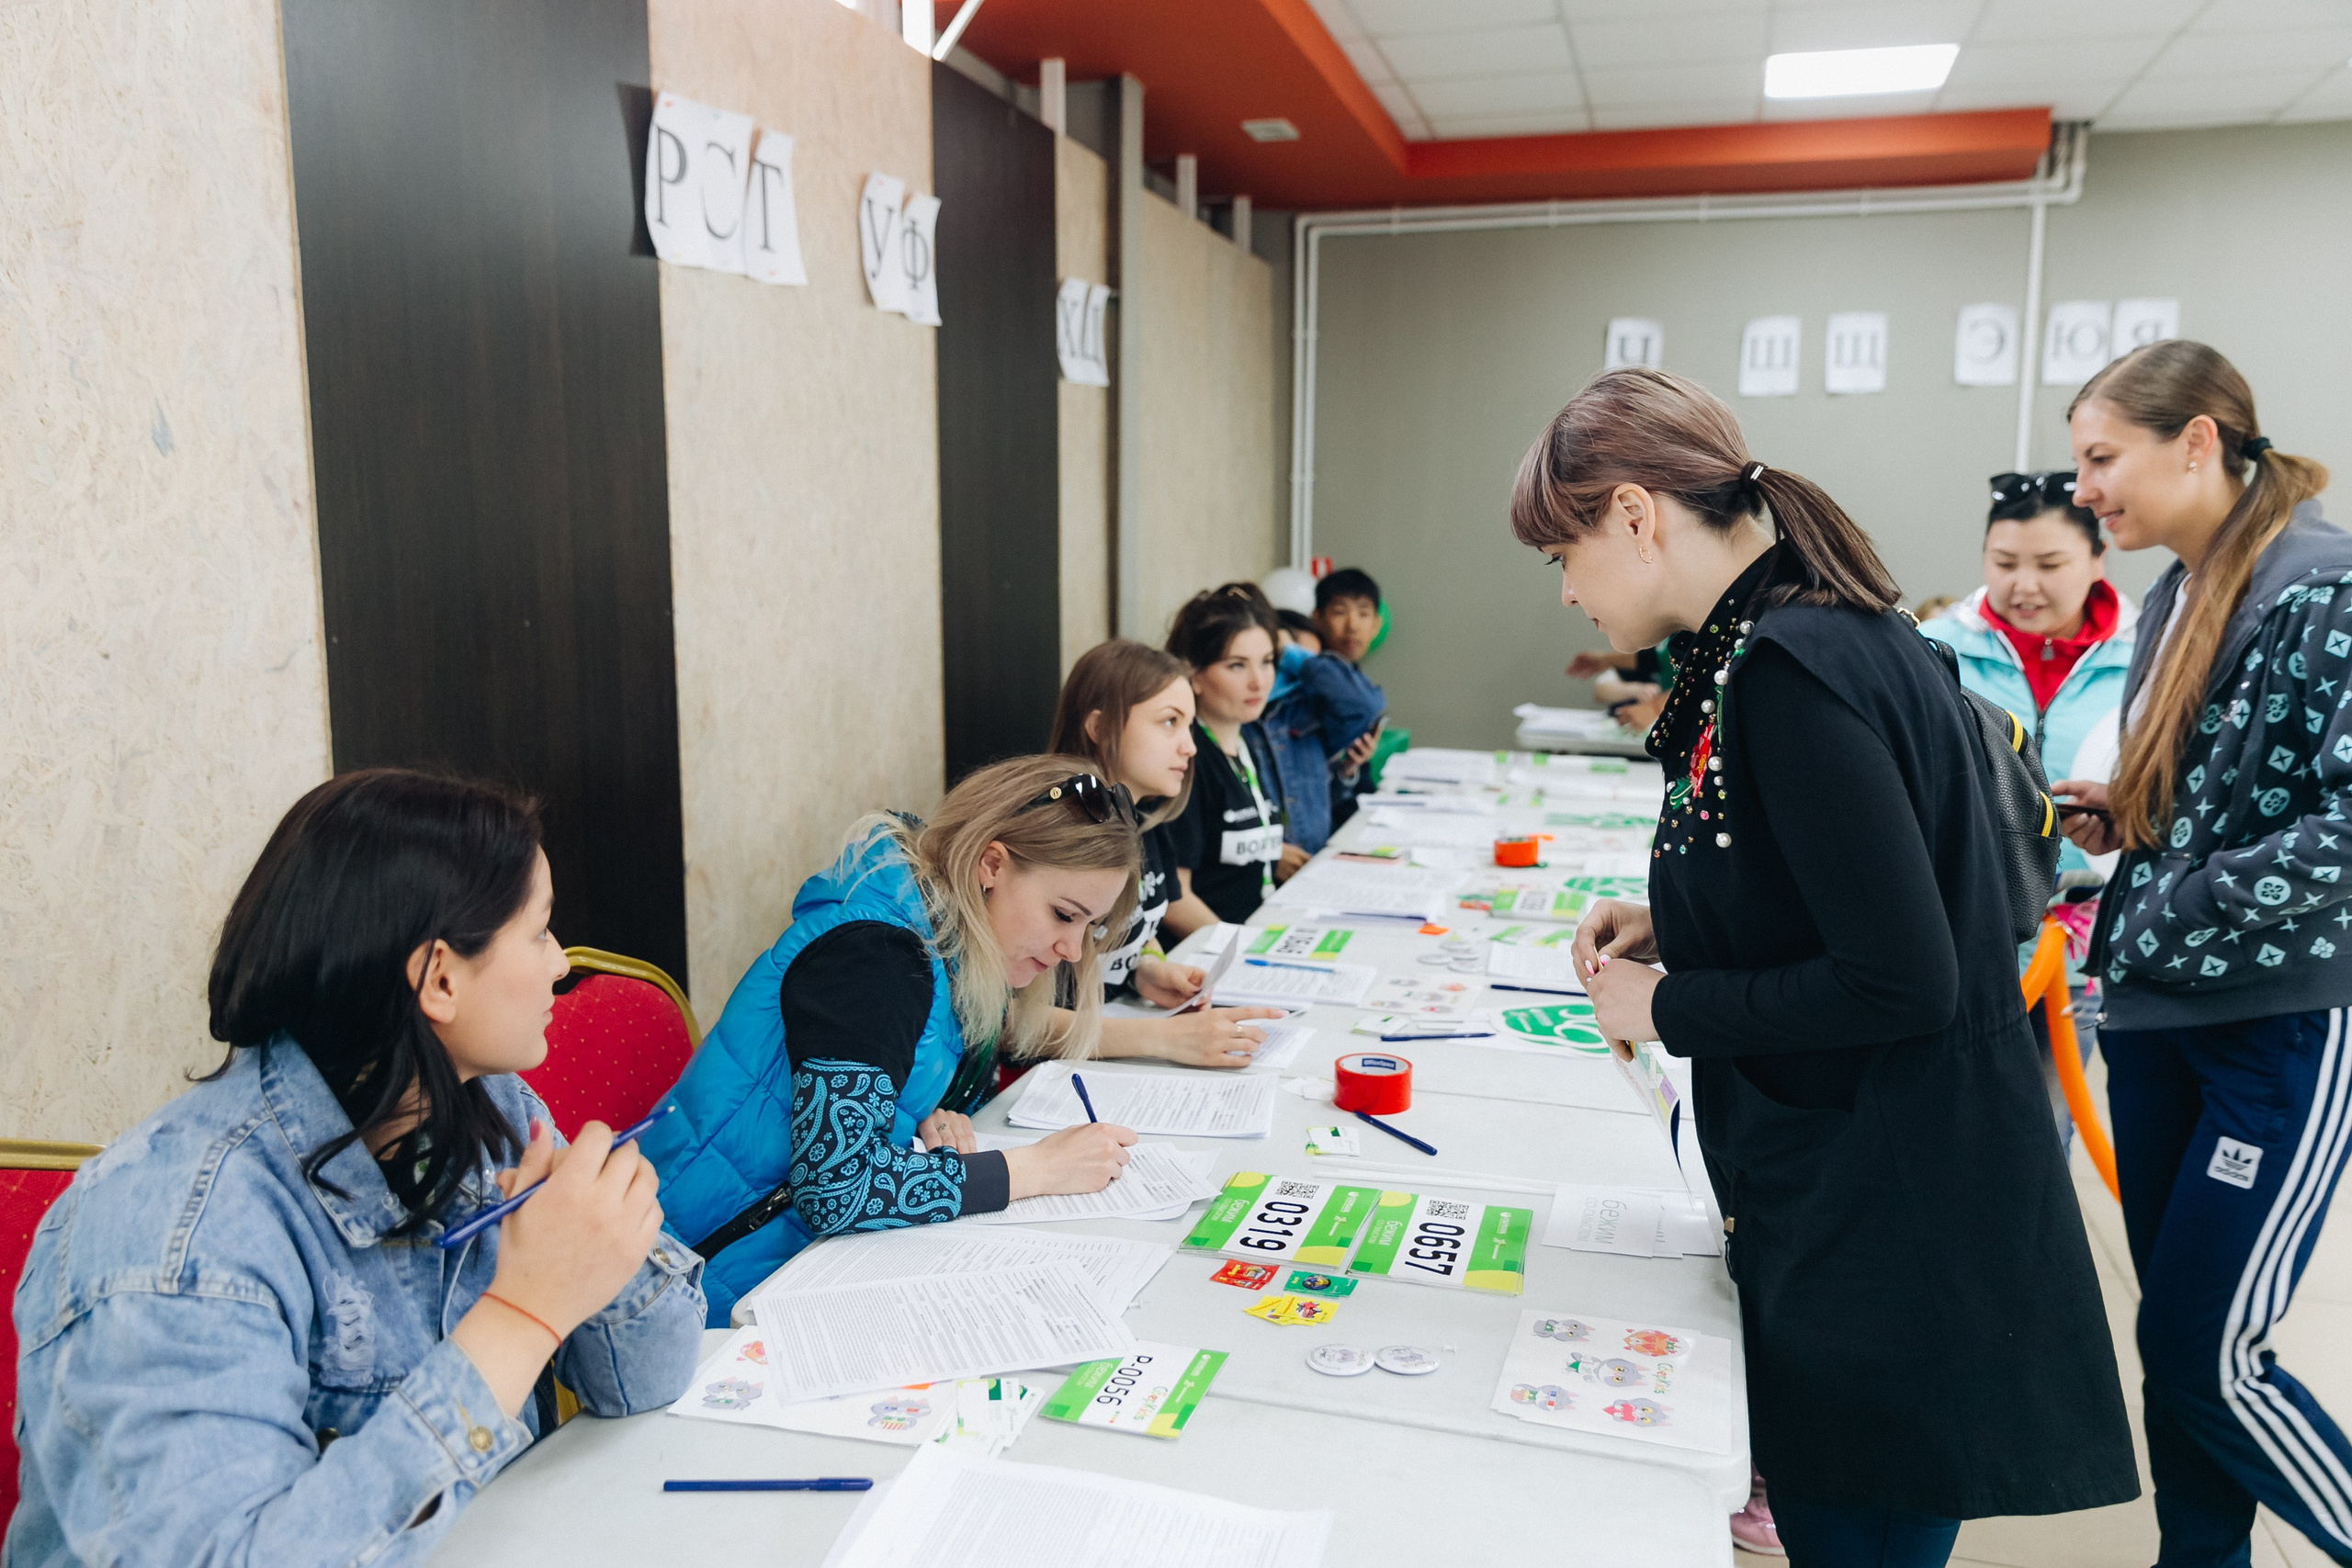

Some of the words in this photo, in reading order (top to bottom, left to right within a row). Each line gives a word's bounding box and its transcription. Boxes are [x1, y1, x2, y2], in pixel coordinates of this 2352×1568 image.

[1239, 1201, 1309, 1251] 0319
[1594, 1200, 1627, 1245] бежим
[1405, 1222, 1465, 1276] 0657
